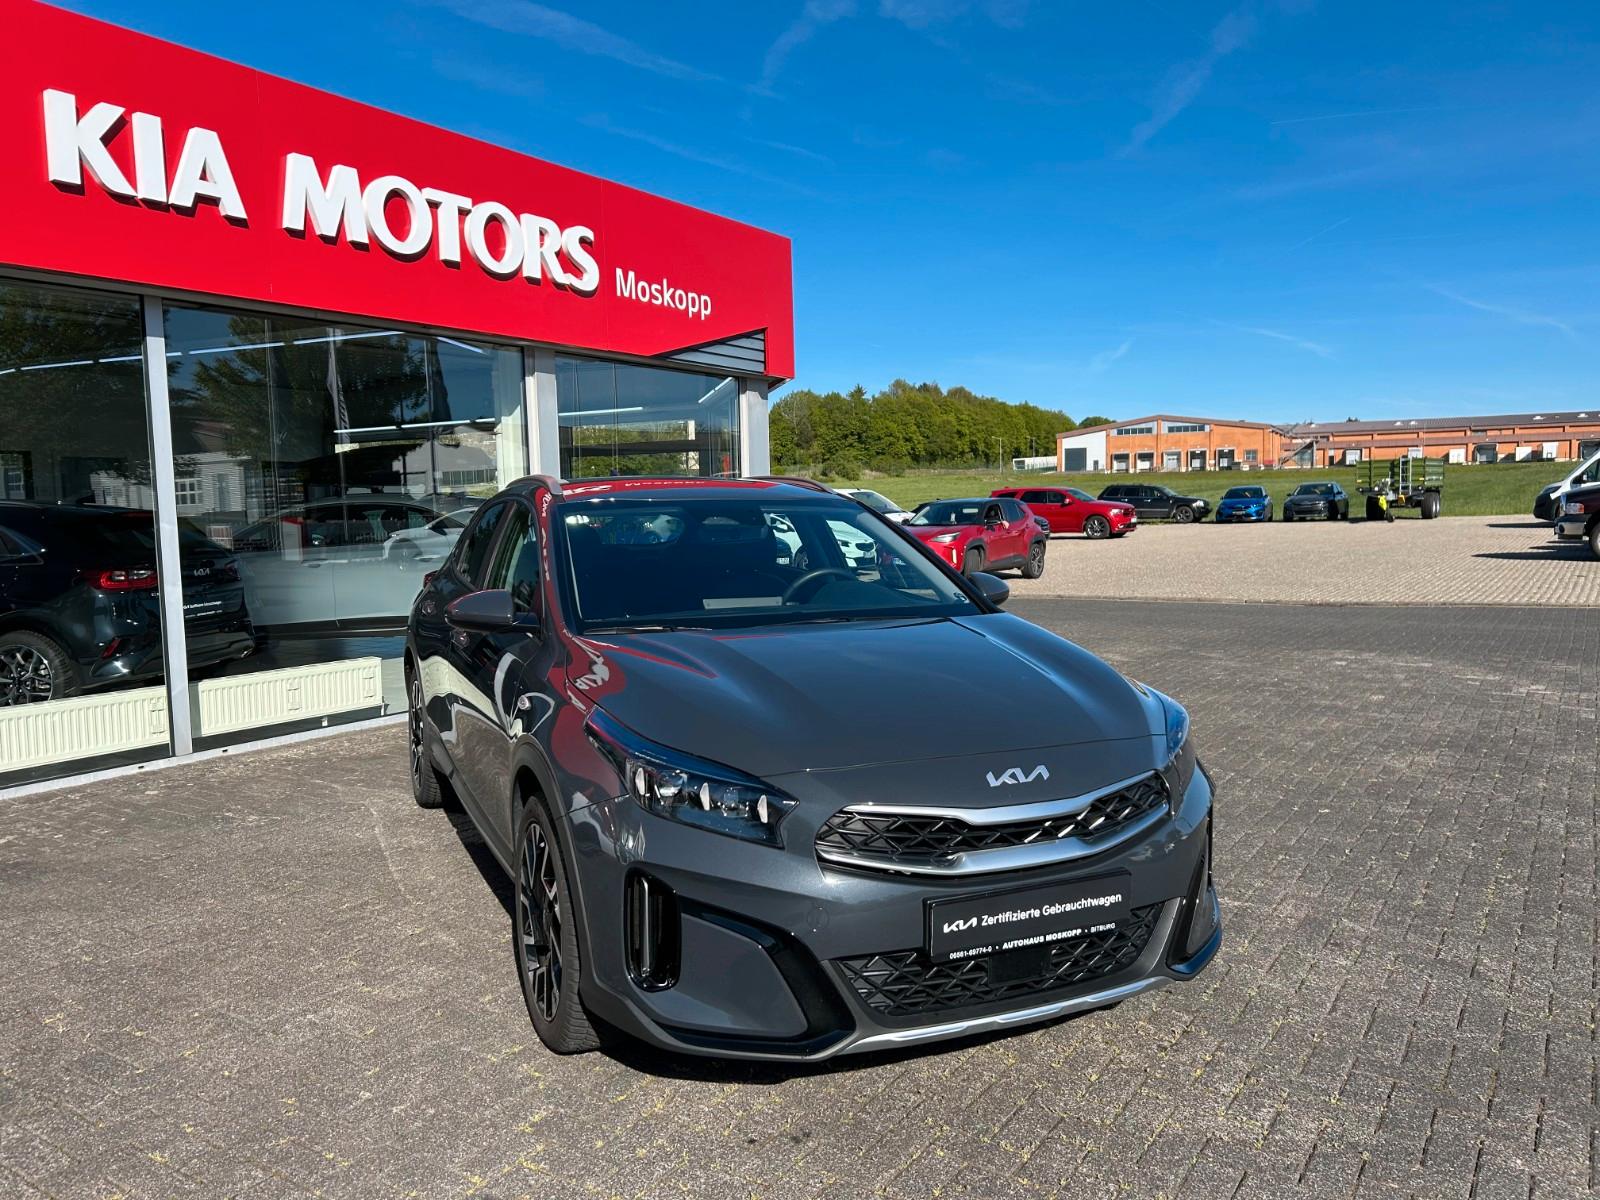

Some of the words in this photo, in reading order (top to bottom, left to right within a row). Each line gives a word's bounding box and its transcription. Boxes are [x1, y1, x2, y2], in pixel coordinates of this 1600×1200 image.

[43, 88, 247, 221] KIA
[282, 152, 600, 293] MOTORS
[615, 268, 713, 321] Moskopp
[986, 765, 1050, 787] KIA
[943, 916, 978, 934] KIA
[981, 908, 1041, 926] Zertifizierte
[1042, 893, 1122, 916] Gebrauchtwagen
[1002, 935, 1045, 950] AUTOHAUS
[1045, 928, 1082, 942] MOSKOPP
